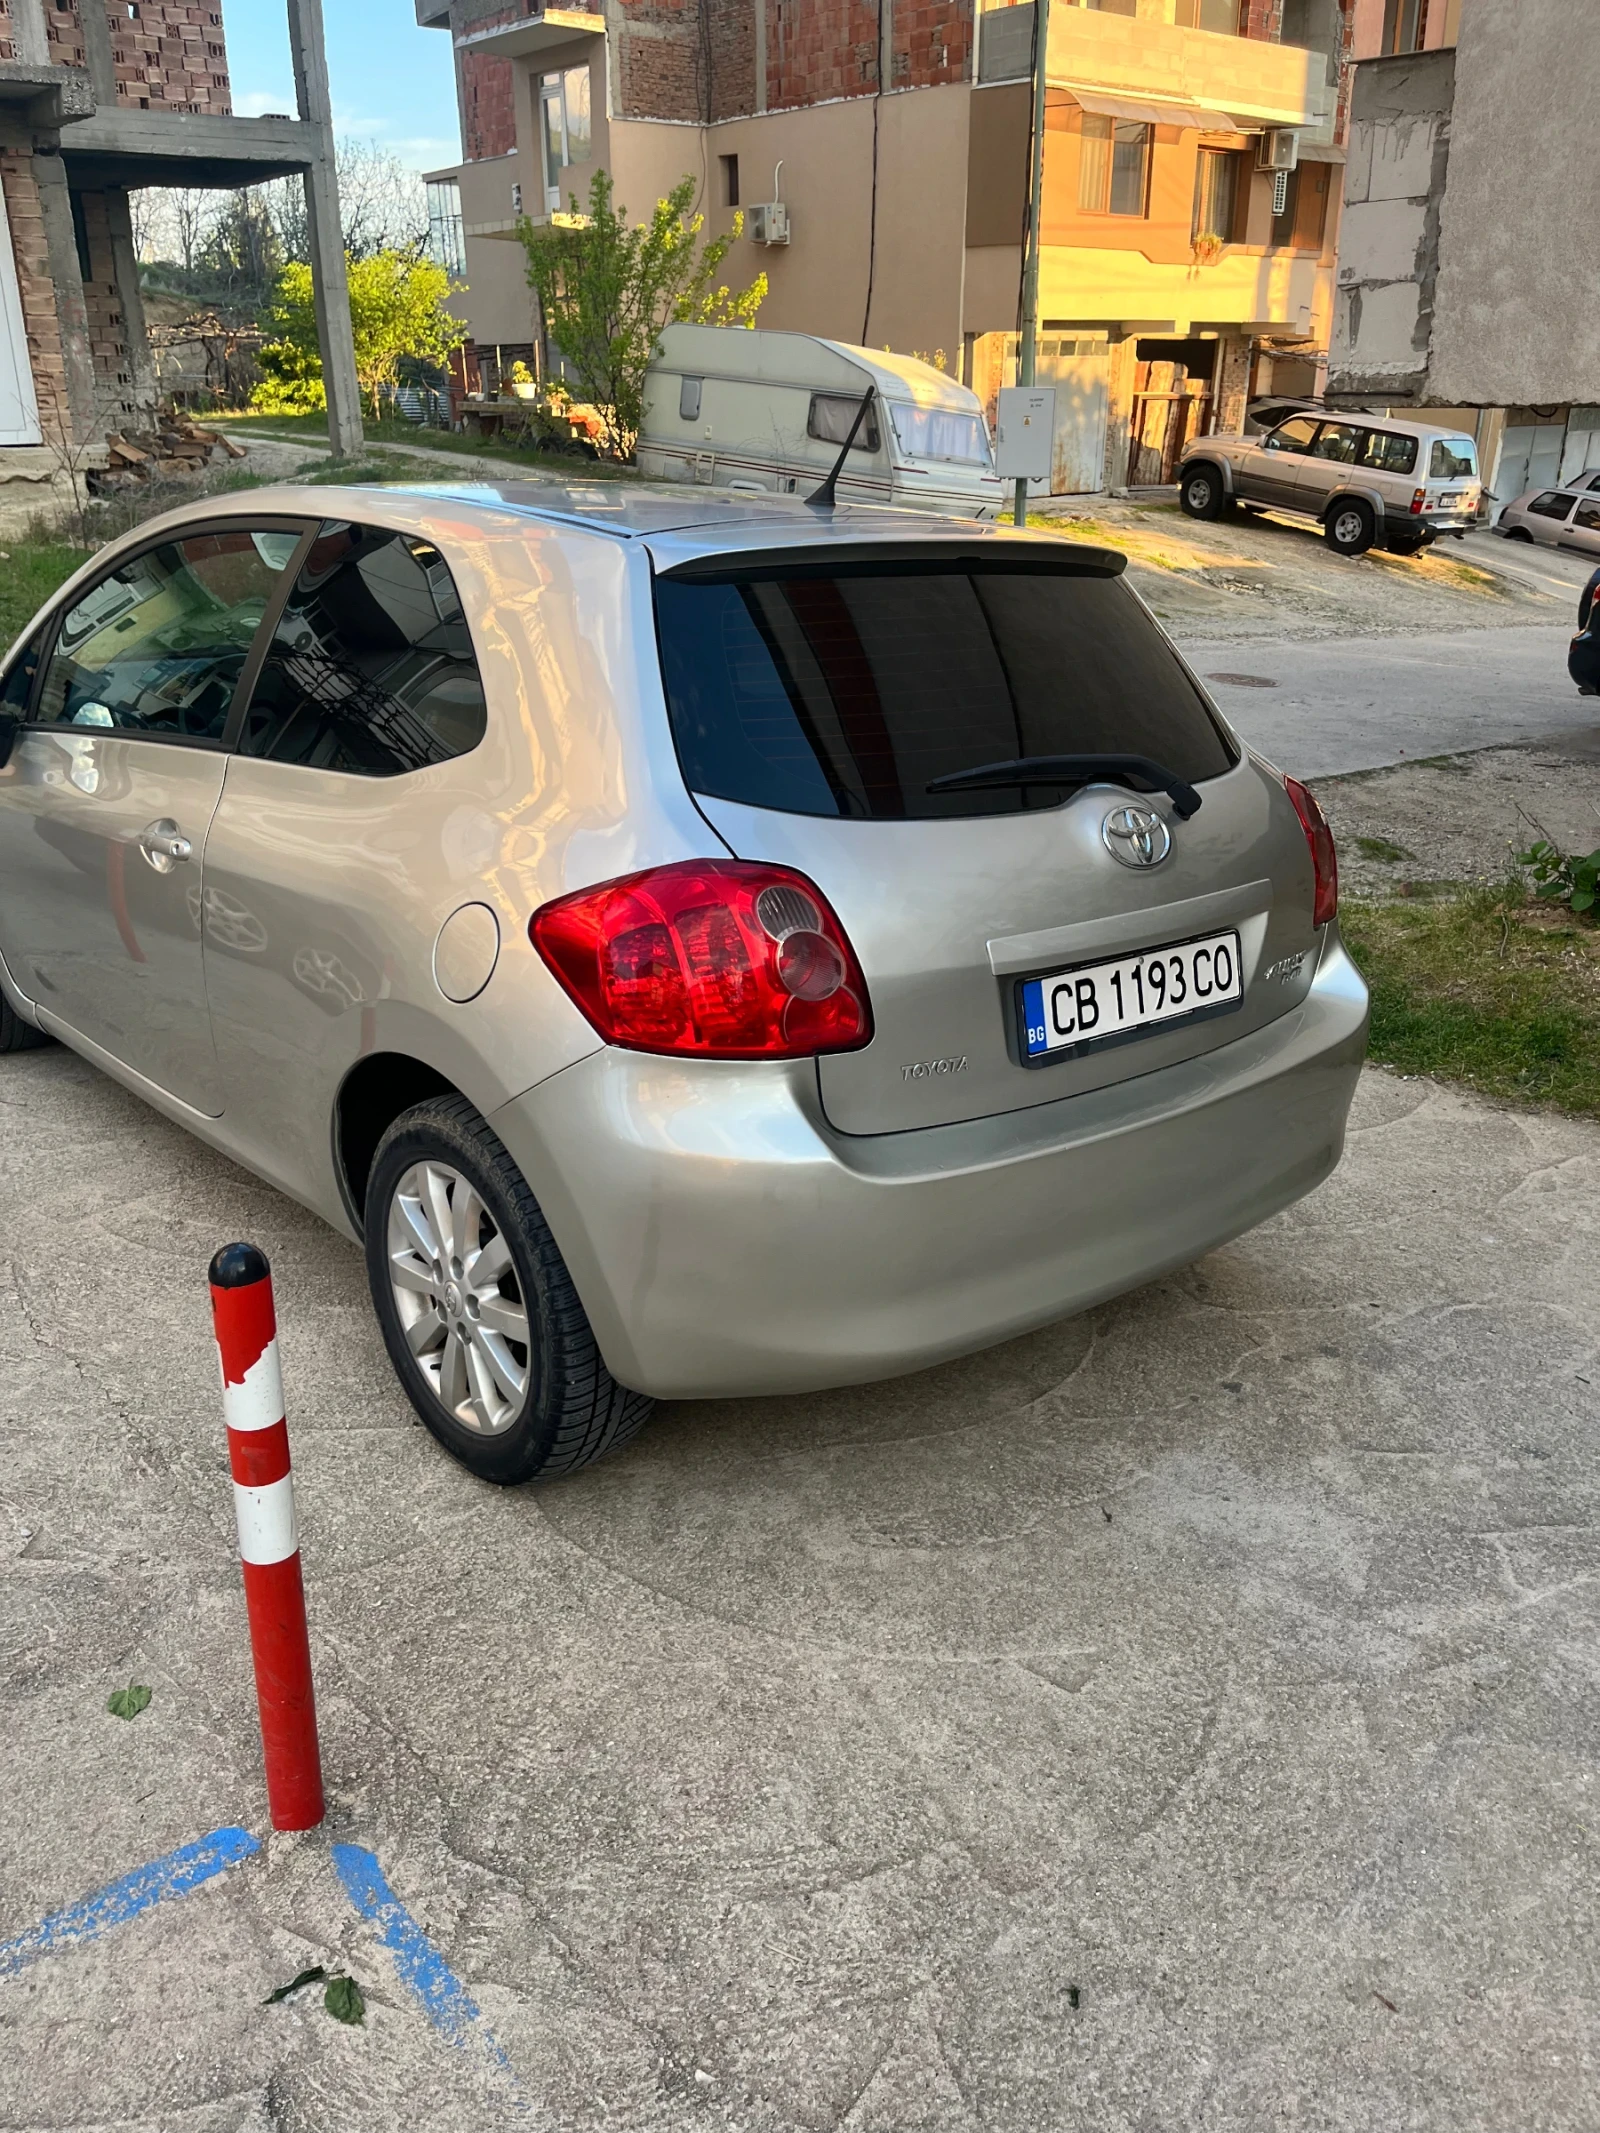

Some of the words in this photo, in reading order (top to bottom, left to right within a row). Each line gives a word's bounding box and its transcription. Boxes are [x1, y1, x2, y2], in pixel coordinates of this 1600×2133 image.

[1051, 977, 1099, 1035] CB
[1110, 956, 1187, 1020] 1193
[1193, 945, 1232, 996] CO
[1028, 1026, 1045, 1044] BG
[901, 1055, 968, 1081] TOYOTA
